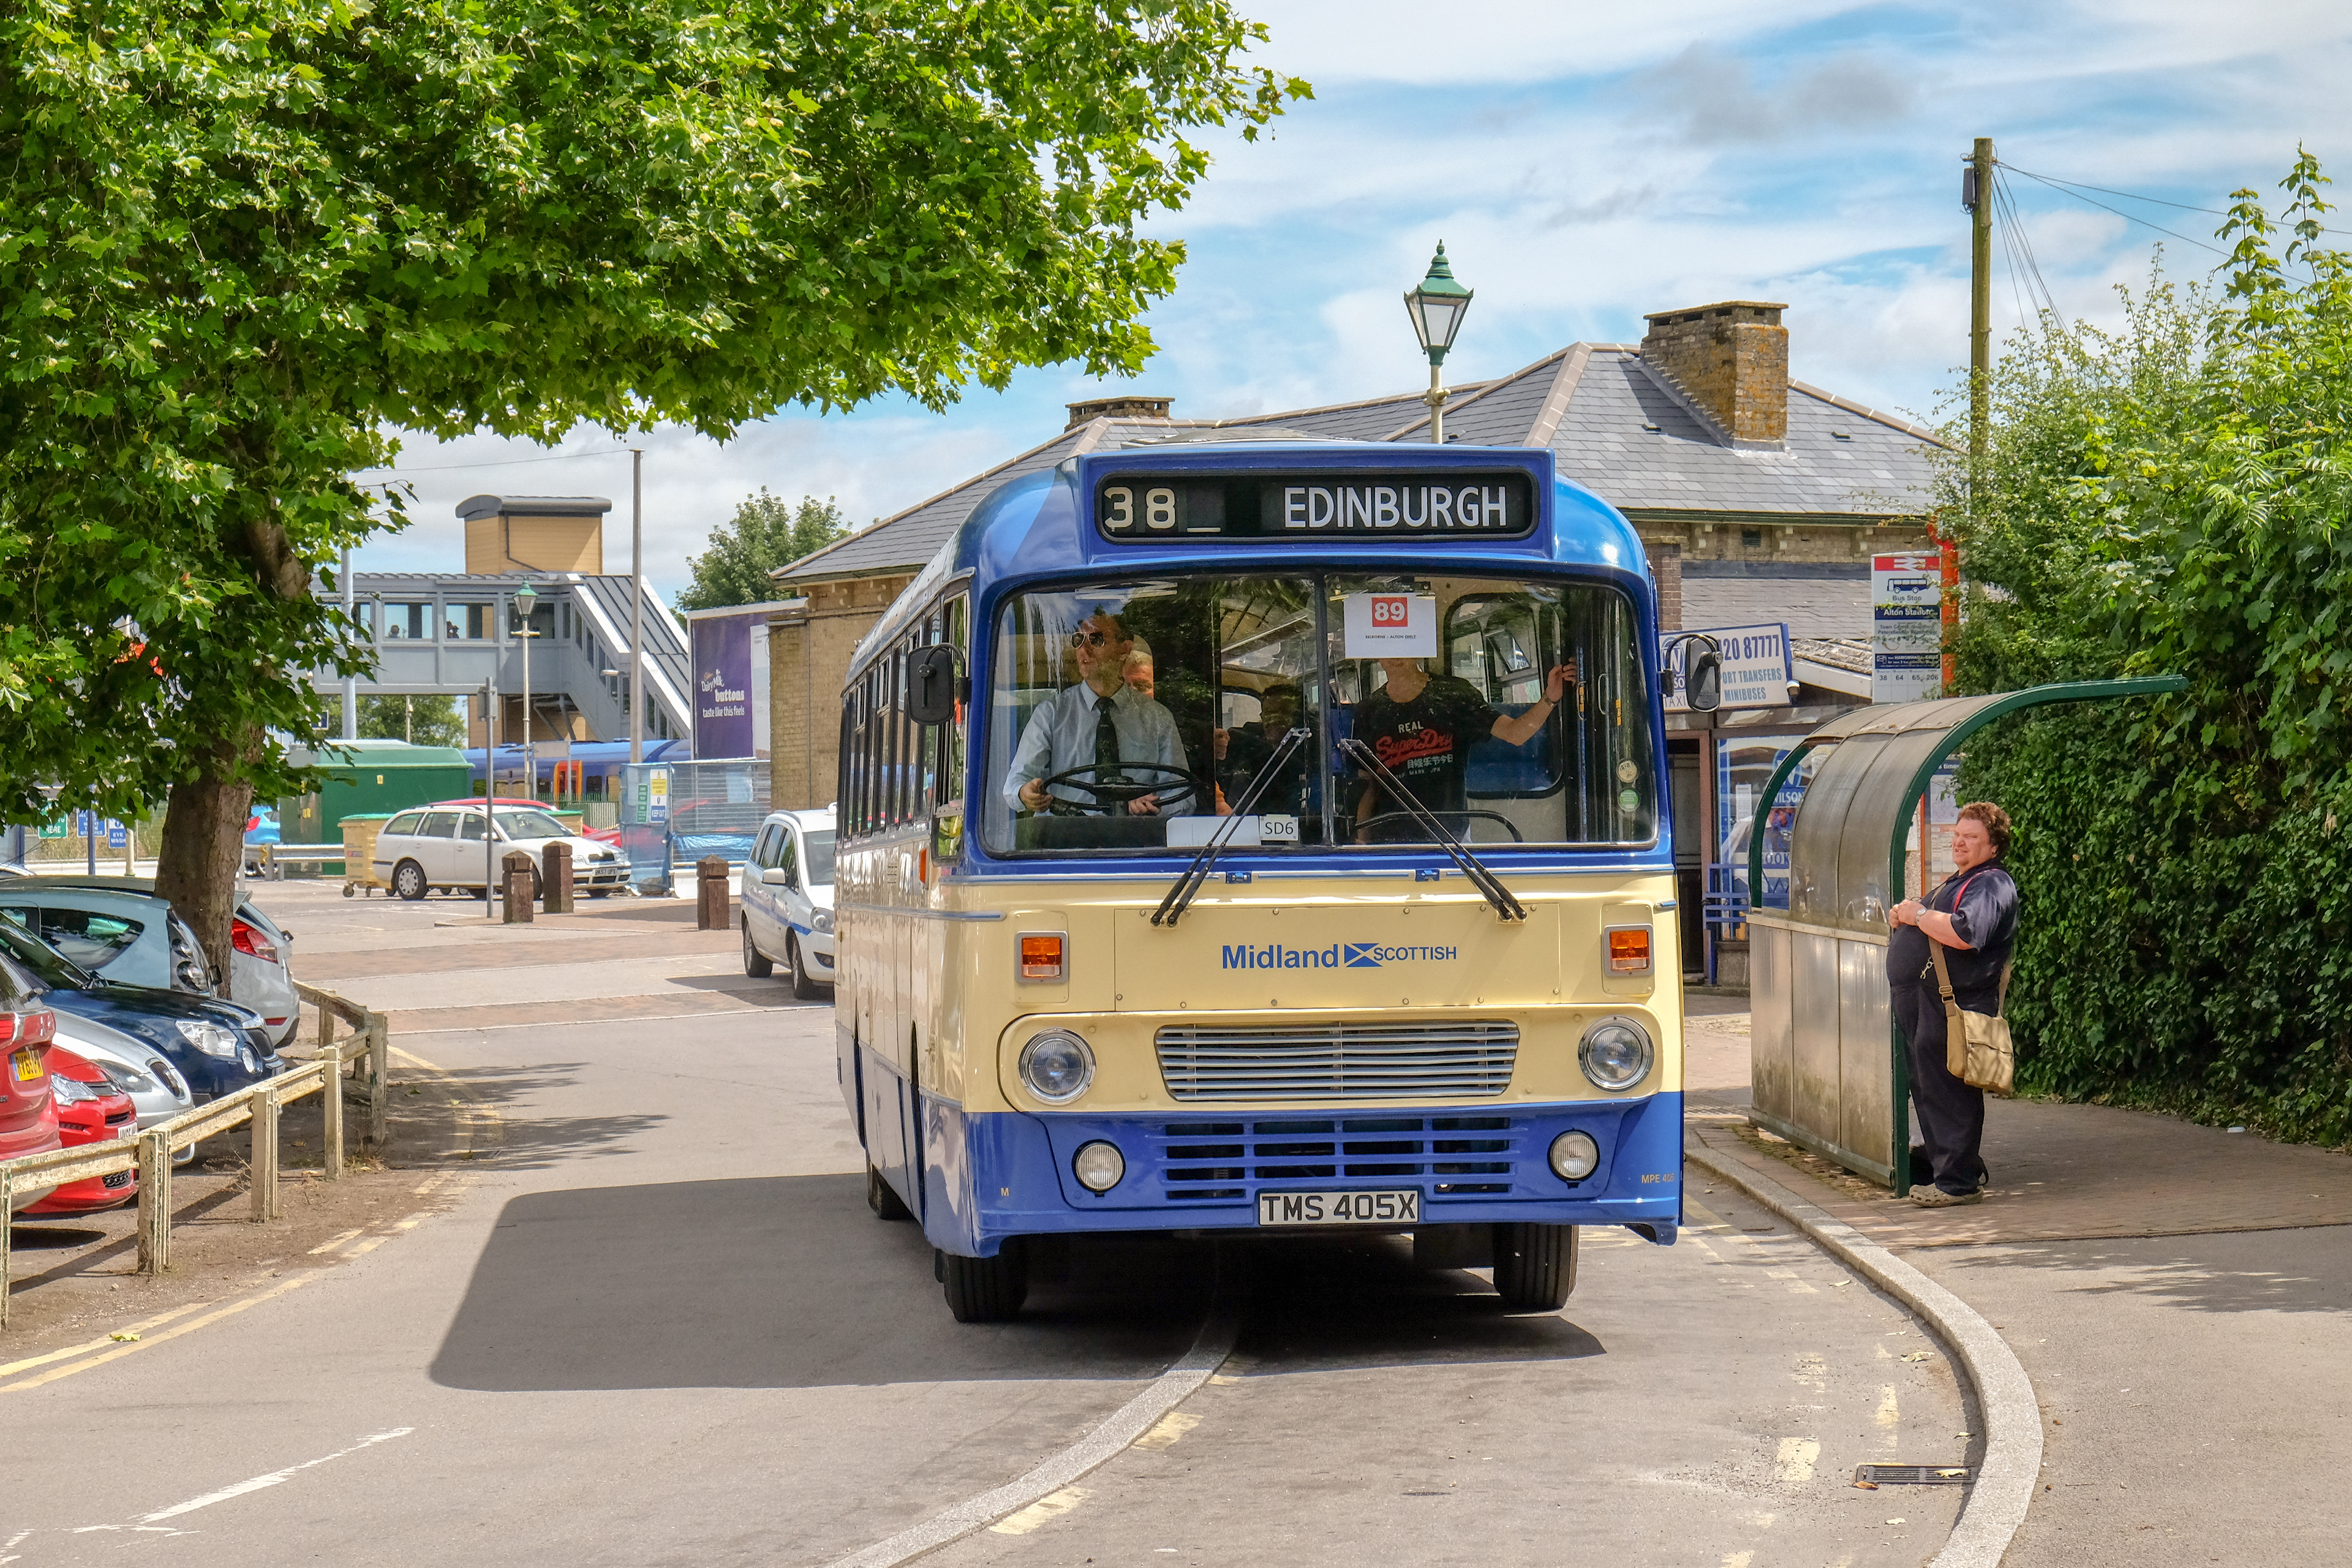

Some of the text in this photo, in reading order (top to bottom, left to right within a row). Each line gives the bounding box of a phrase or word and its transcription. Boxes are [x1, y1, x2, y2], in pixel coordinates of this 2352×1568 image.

[1104, 486, 1507, 529] 38 EDINBURGH
[1374, 602, 1405, 621] 89
[1744, 634, 1779, 659] 87777
[1721, 668, 1782, 684] ORT TRANSFERS
[715, 688, 744, 702] buttons
[1724, 687, 1766, 701] MINIBUSES
[703, 707, 715, 718] taste
[723, 706, 733, 717] this
[1398, 721, 1424, 734] REAL
[1265, 821, 1294, 835] SD6
[1222, 944, 1457, 969] Midland SCOTTISH
[1642, 1174, 1660, 1184] MPE
[1001, 1187, 1009, 1196] M
[1262, 1194, 1416, 1221] TMS 405X
